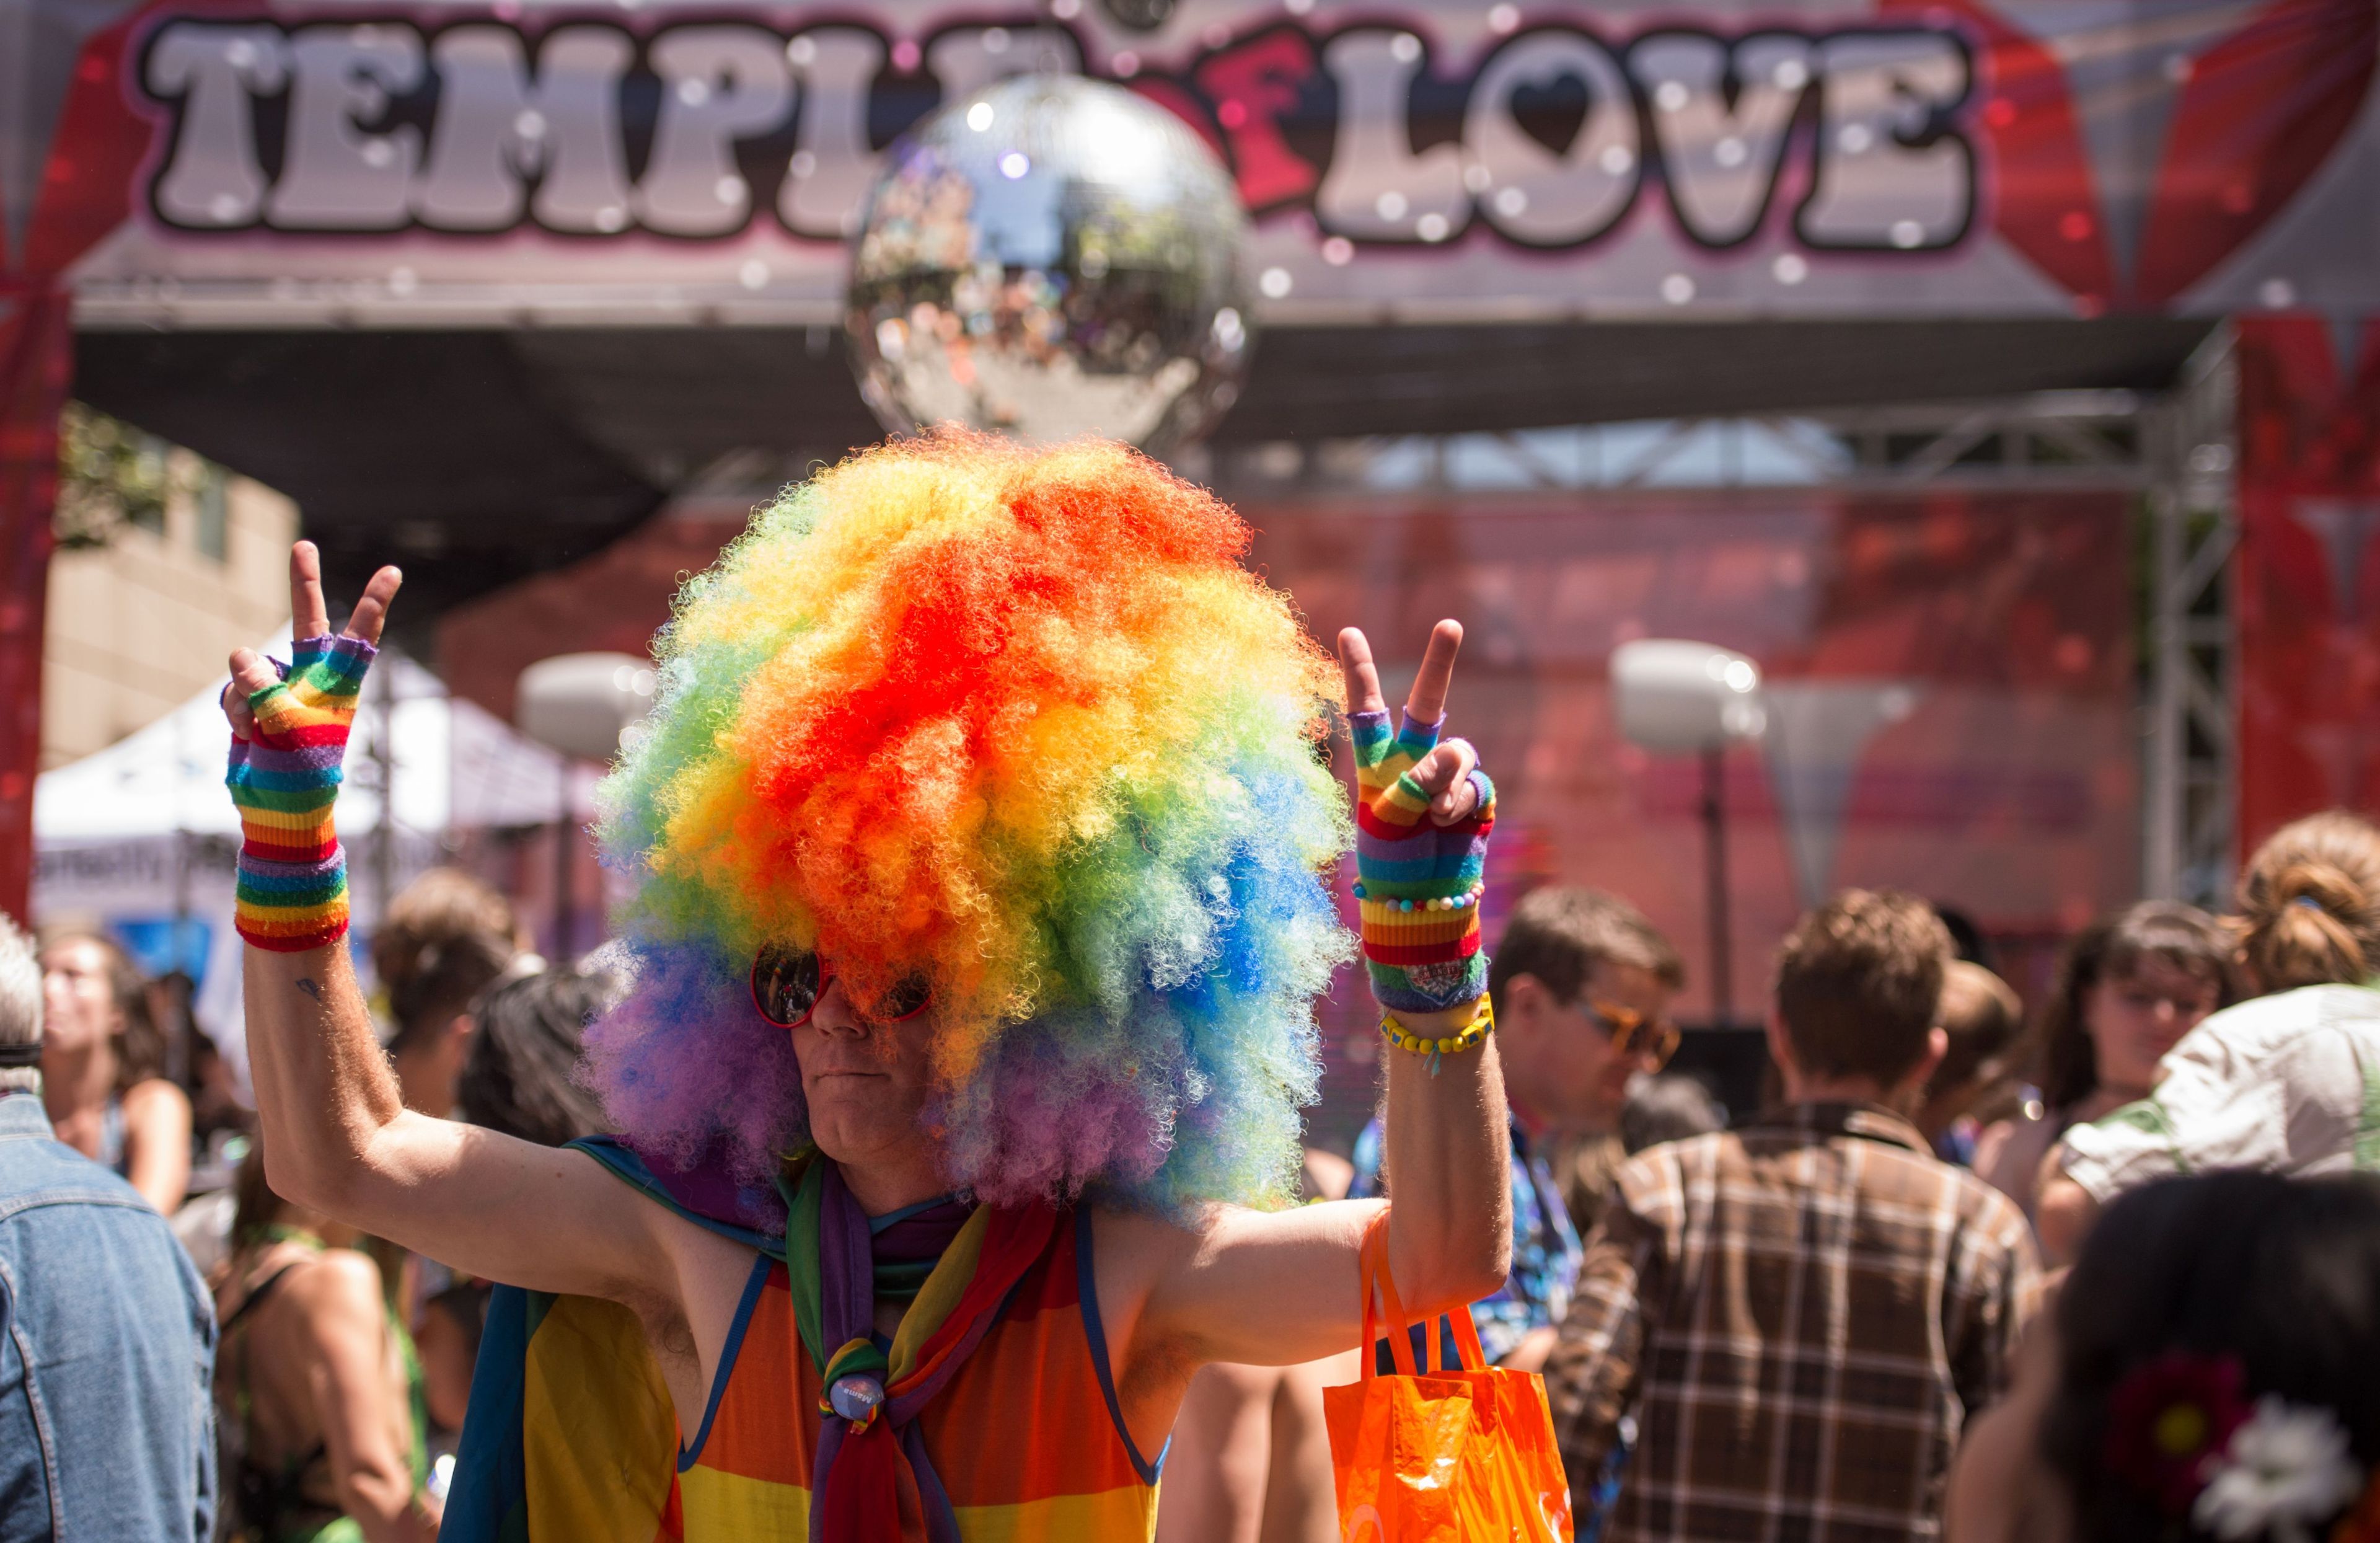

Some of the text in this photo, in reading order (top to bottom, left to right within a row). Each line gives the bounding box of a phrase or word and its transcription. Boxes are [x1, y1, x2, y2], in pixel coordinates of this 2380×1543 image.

[1125, 30, 1315, 210] F
[1317, 29, 1970, 244] LOVE
[844, 1388, 872, 1404] Mama
